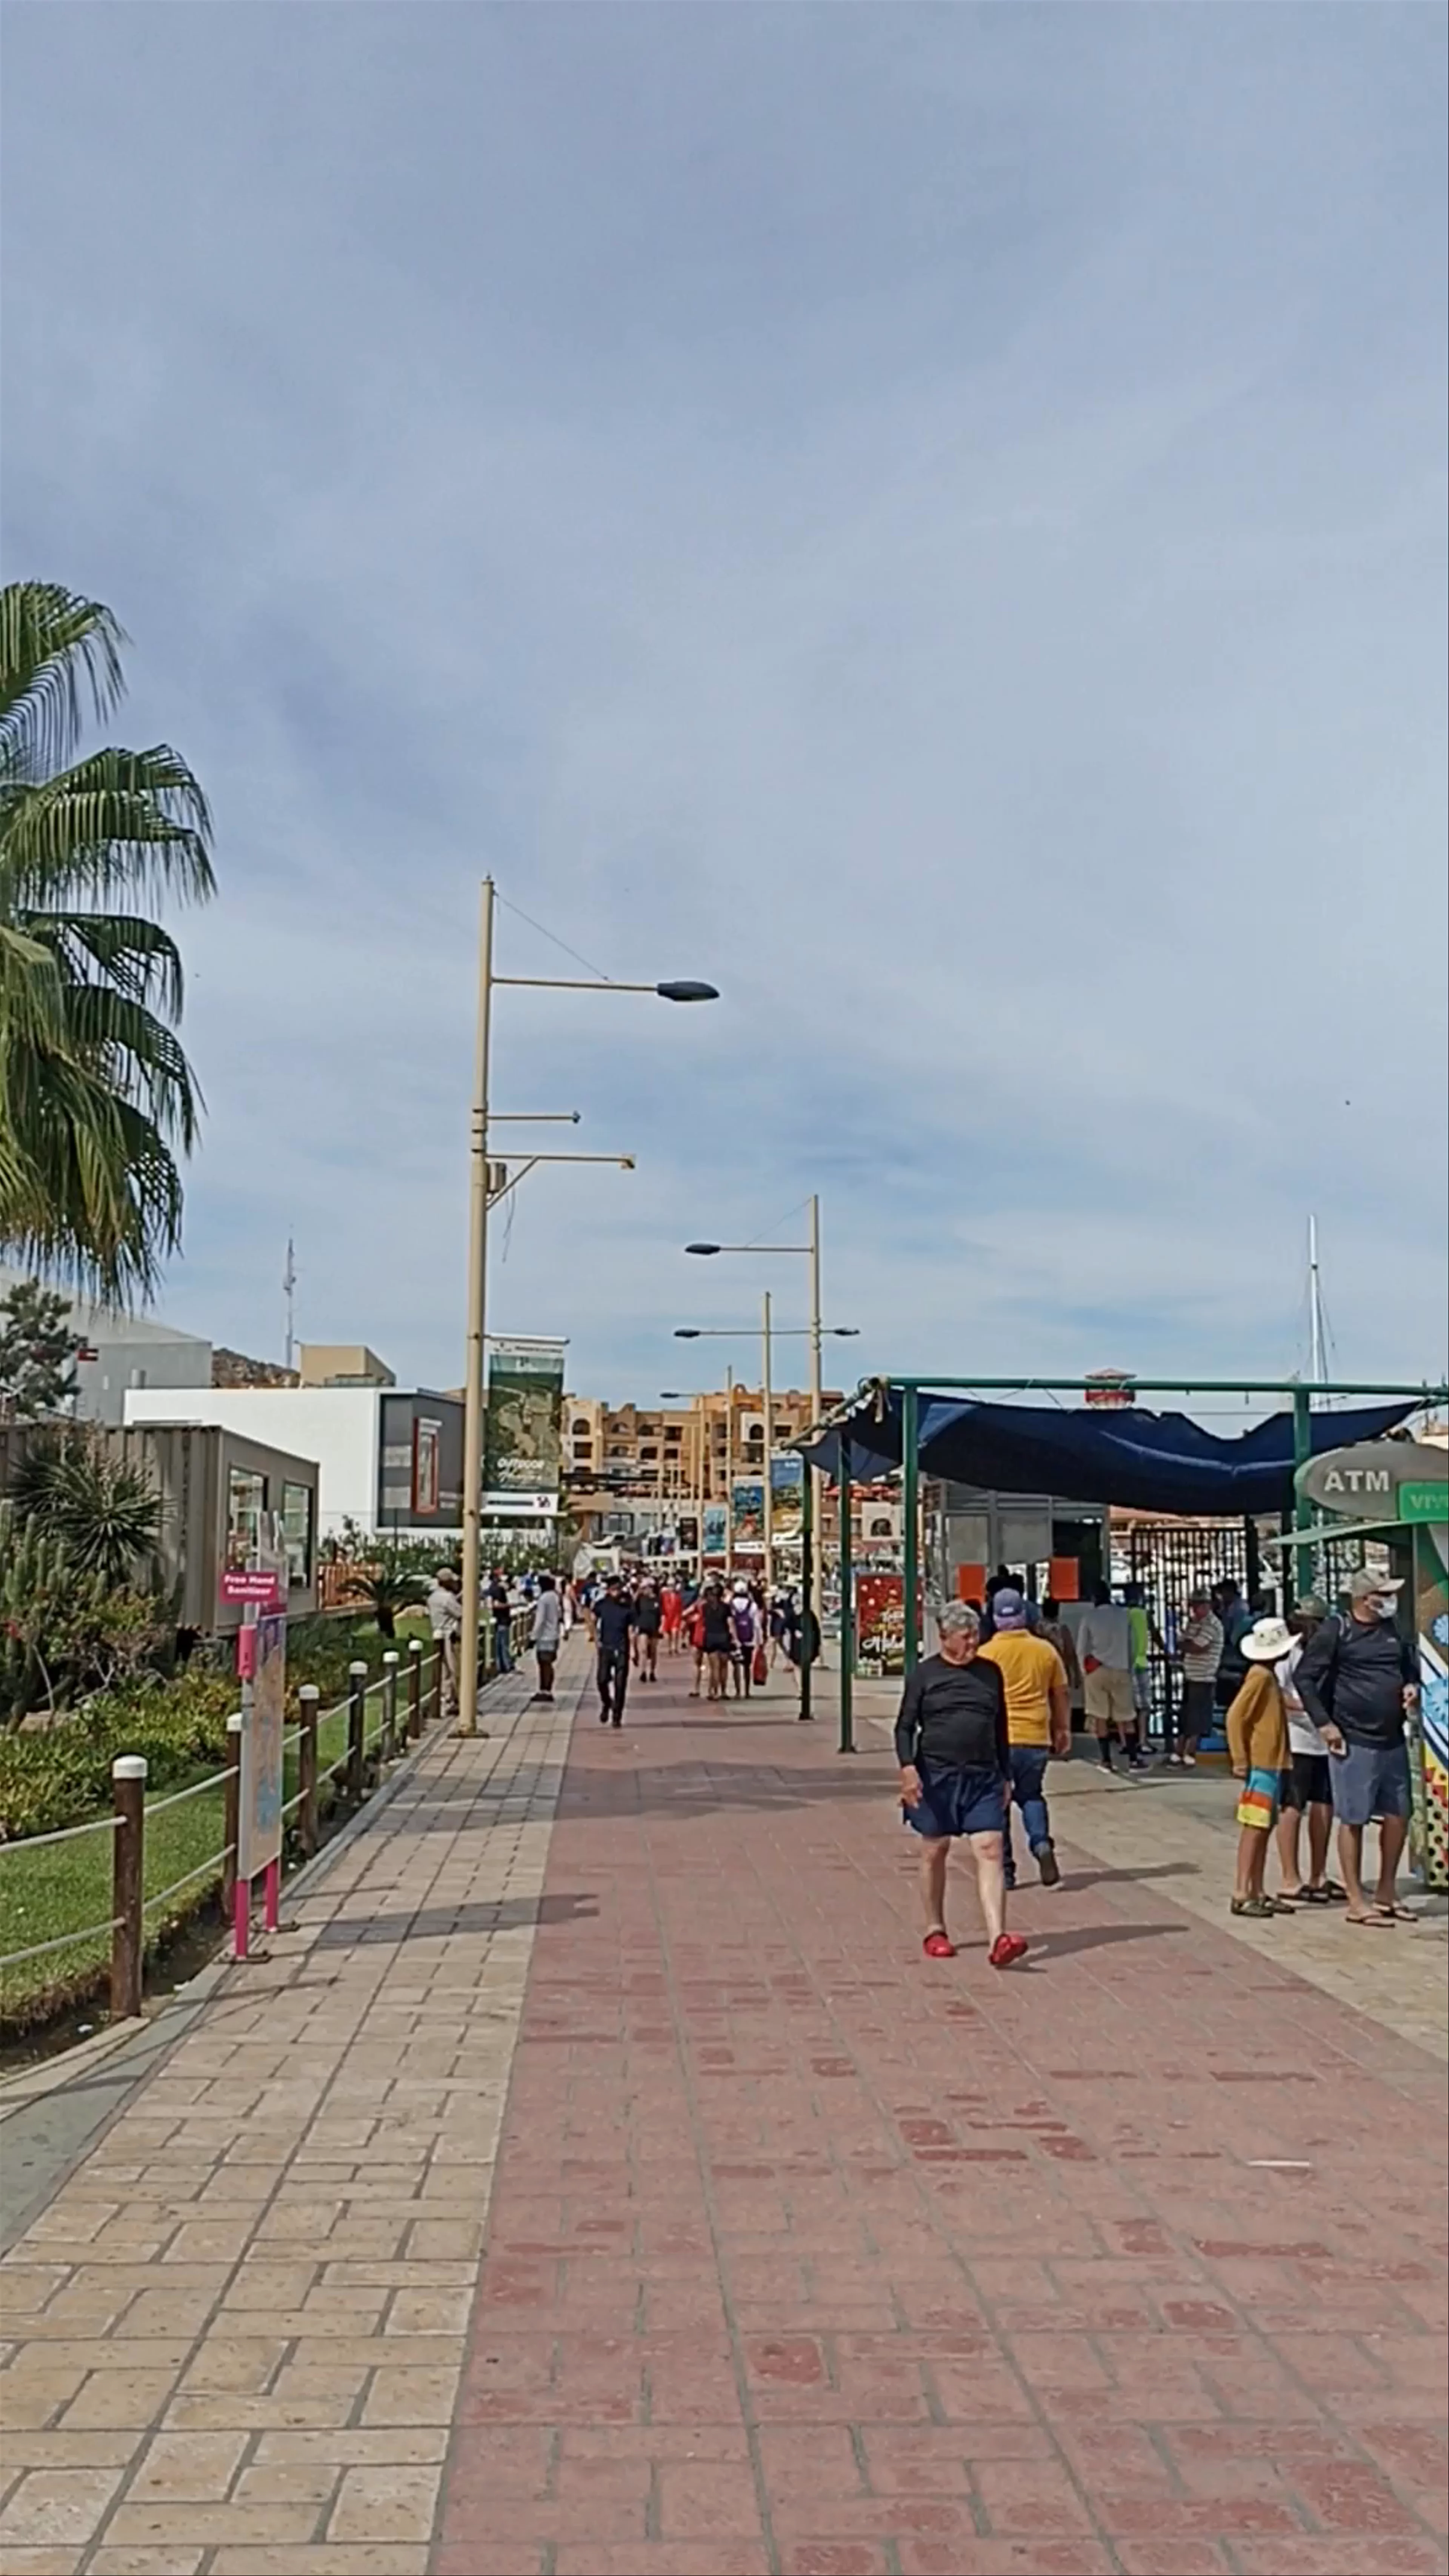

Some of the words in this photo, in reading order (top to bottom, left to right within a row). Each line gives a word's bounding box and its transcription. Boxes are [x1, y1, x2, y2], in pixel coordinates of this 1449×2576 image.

[1324, 1470, 1390, 1492] ATM
[224, 1575, 247, 1584] Free
[249, 1575, 275, 1585] Hand
[227, 1586, 271, 1595] Sanitizer
